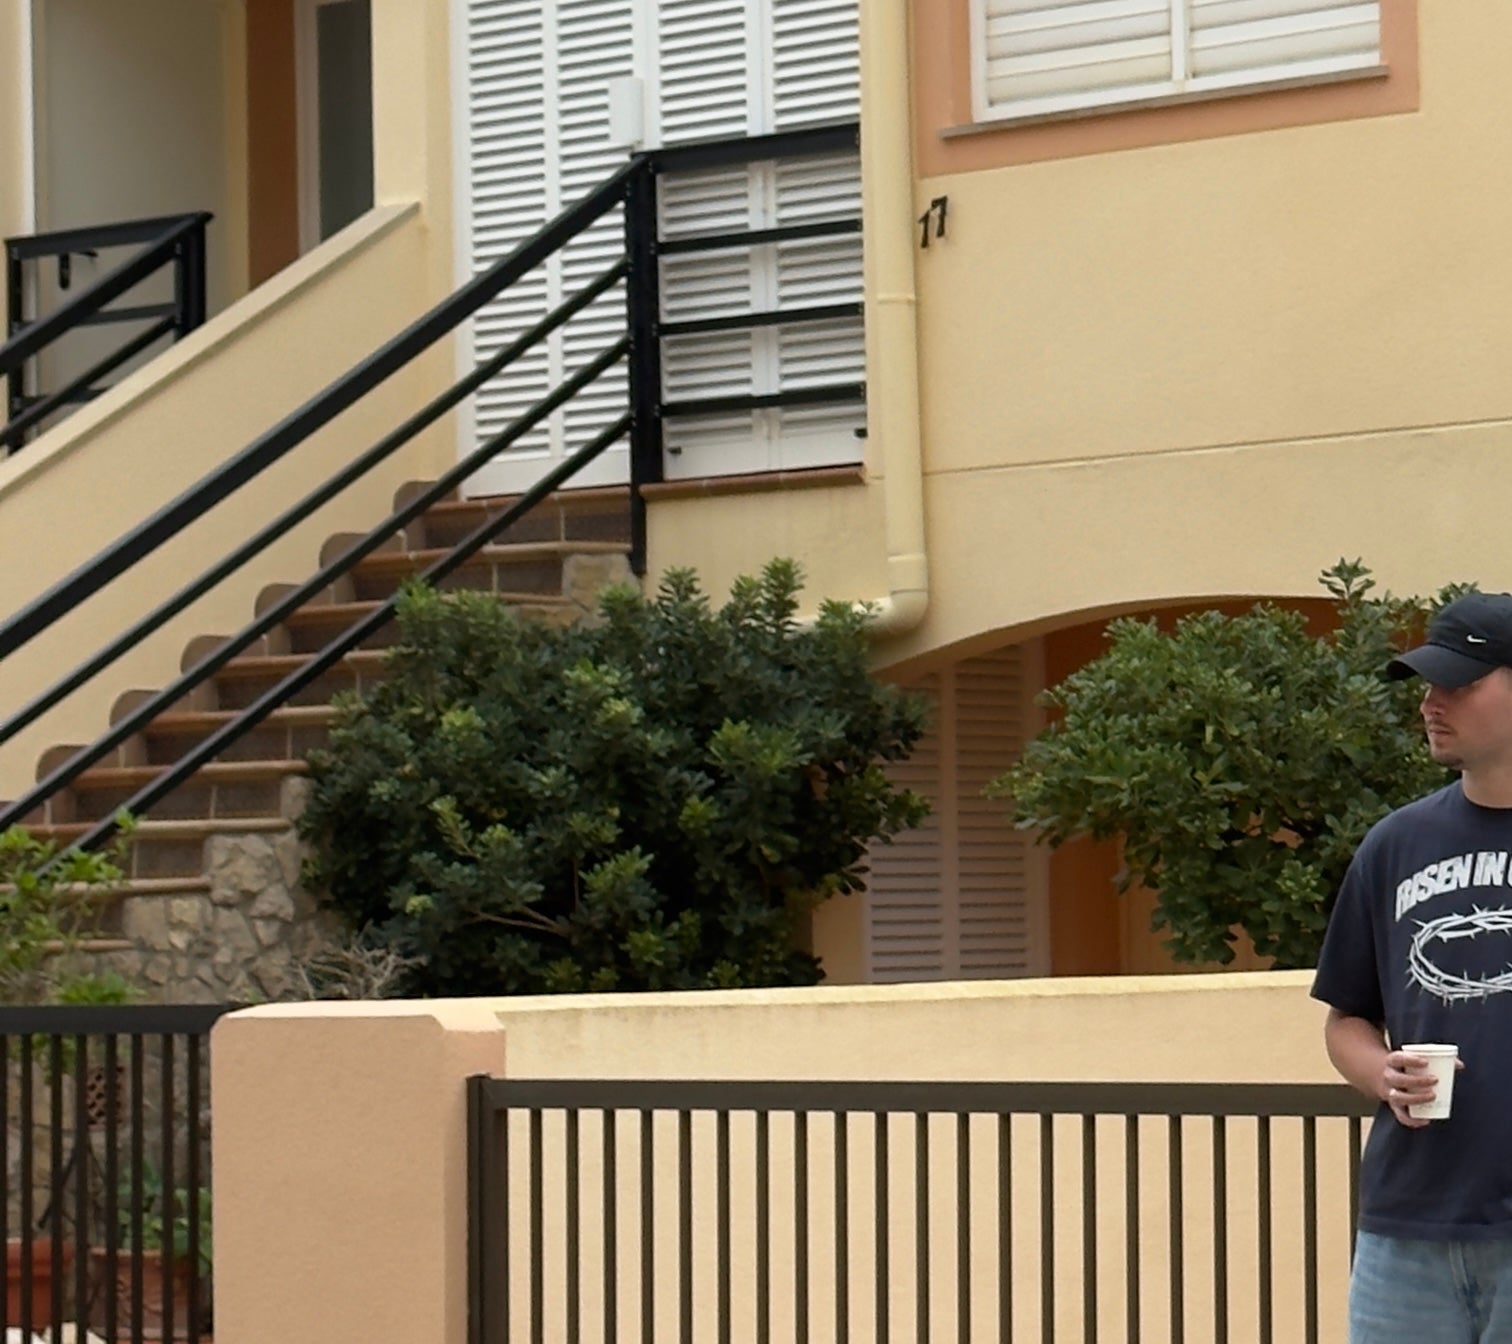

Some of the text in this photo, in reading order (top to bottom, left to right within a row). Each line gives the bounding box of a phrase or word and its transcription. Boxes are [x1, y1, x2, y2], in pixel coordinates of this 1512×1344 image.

[917, 195, 949, 249] 17
[1395, 853, 1473, 922] RISEN
[1473, 851, 1508, 887] IN
